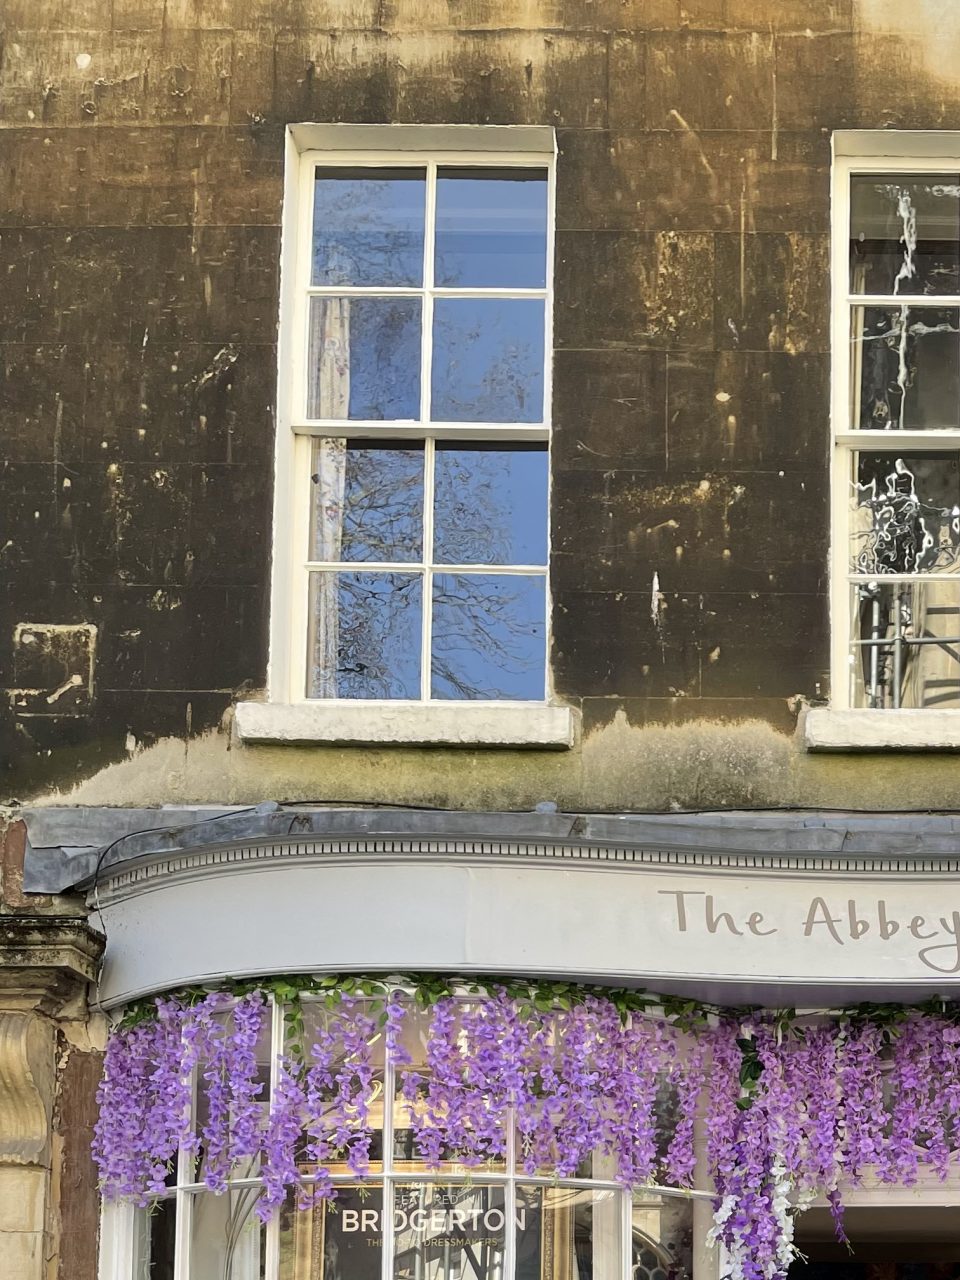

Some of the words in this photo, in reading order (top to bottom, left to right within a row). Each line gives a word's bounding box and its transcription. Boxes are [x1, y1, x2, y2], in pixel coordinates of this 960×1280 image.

[658, 889, 778, 937] The
[394, 1194, 459, 1205] FEATRED
[342, 1208, 526, 1232] BRIDGERTON
[424, 1237, 498, 1248] DRESSMAKERS
